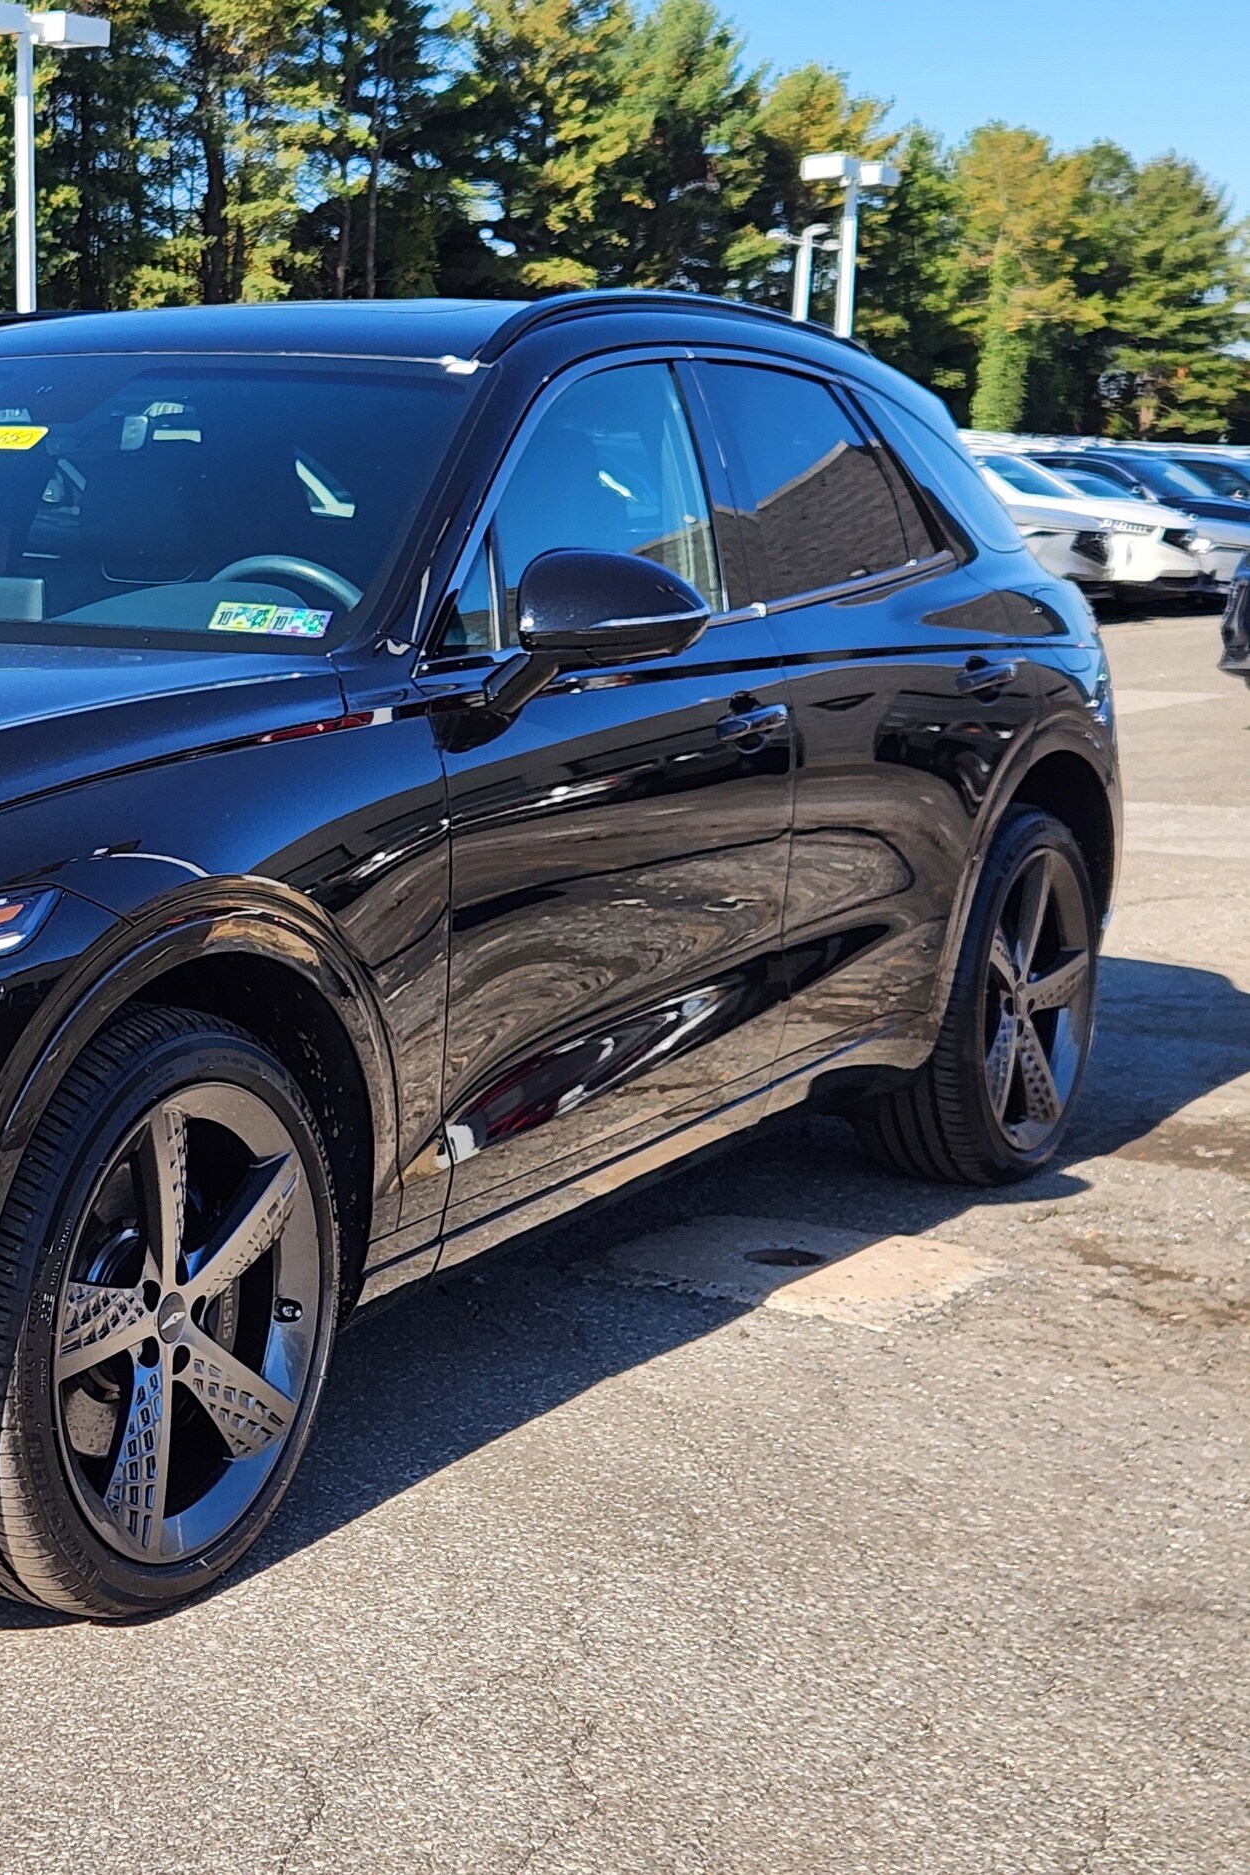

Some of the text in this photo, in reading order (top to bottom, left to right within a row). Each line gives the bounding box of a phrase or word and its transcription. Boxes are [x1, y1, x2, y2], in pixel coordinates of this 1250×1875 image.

[217, 610, 233, 626] 10
[272, 615, 288, 631] 10
[222, 1283, 233, 1340] NESIS
